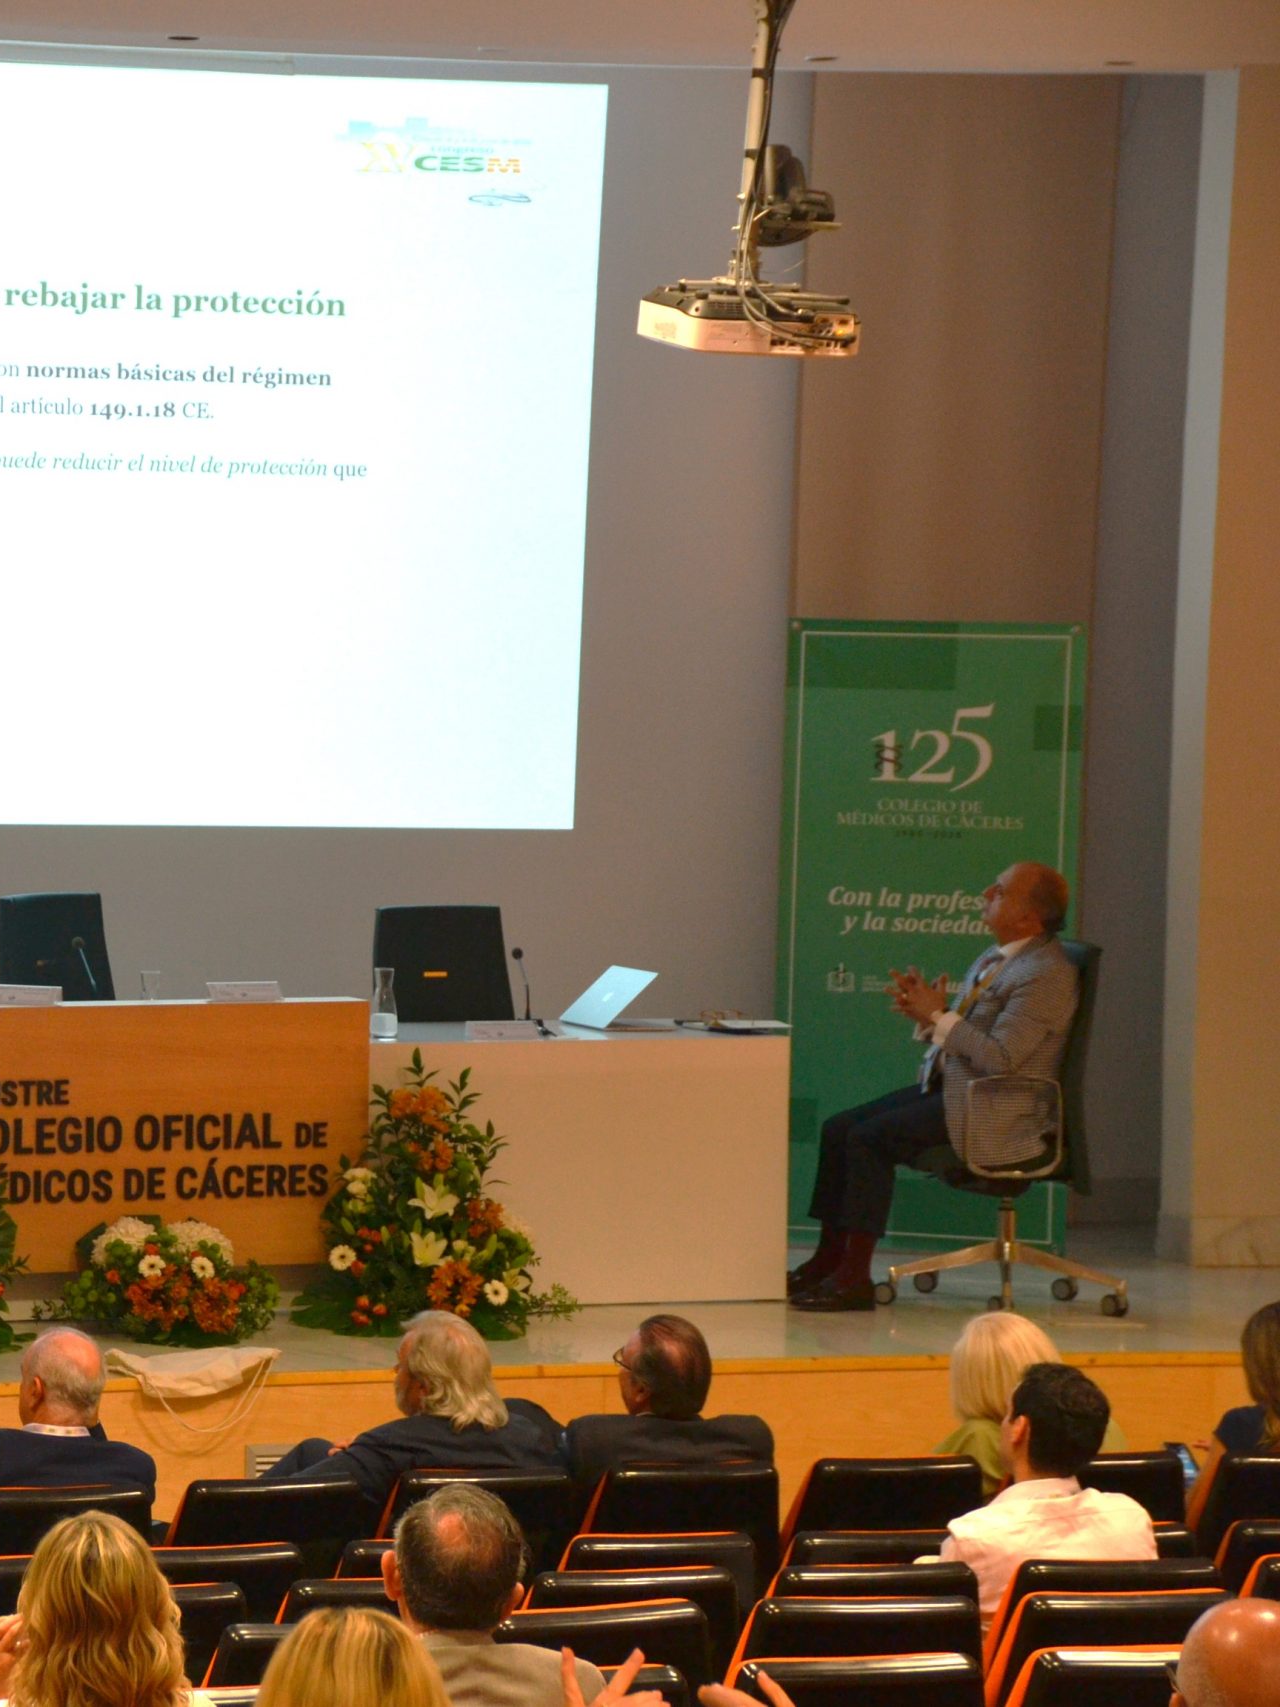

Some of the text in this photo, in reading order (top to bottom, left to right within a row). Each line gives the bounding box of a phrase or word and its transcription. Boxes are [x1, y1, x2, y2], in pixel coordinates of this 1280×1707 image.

[414, 156, 521, 173] CESM
[5, 281, 126, 315] rebajar
[135, 284, 164, 312] la
[172, 289, 346, 318] protección
[26, 365, 111, 380] normas
[117, 362, 197, 383] básicas
[202, 364, 235, 384] del
[241, 366, 332, 389] régimen
[11, 397, 84, 416] artículo
[90, 401, 176, 421] 149.1.18
[182, 402, 215, 420] CE.
[52, 452, 123, 472] reducir
[127, 453, 145, 472] el
[149, 455, 197, 474] nivel
[200, 456, 224, 475] de
[226, 458, 329, 480] protección
[333, 464, 368, 482] que
[871, 702, 995, 792] 125
[836, 809, 915, 826] MÉDICOS
[919, 813, 942, 828] DE
[877, 798, 983, 814] COLEGIO DE
[828, 886, 984, 914] Con la profes
[840, 911, 994, 935] y la socieda
[134, 1112, 282, 1152] OFICIAL
[294, 1121, 329, 1149] DE
[123, 1166, 166, 1201] DE
[175, 1156, 329, 1200] CÁCERES
